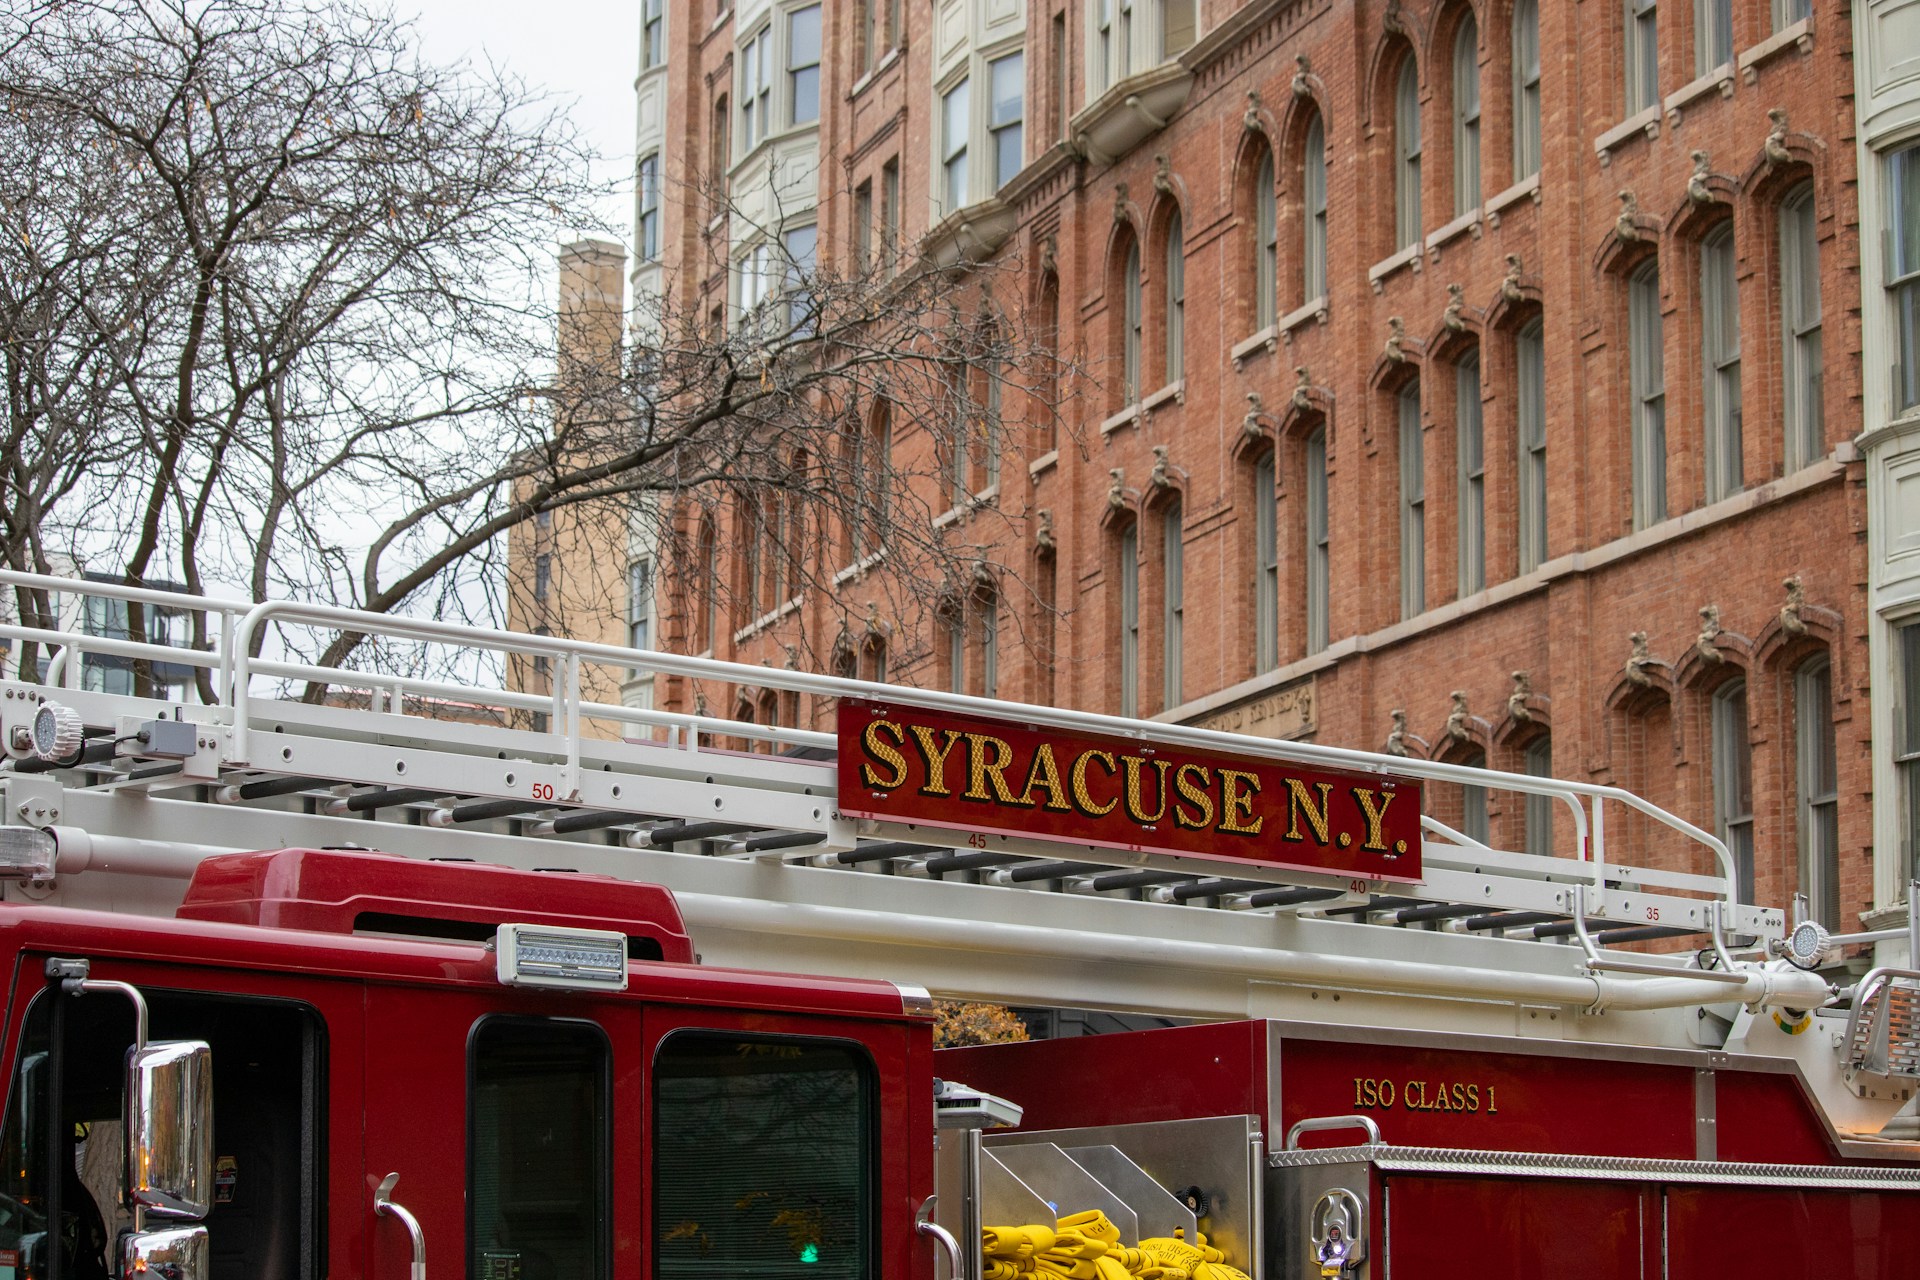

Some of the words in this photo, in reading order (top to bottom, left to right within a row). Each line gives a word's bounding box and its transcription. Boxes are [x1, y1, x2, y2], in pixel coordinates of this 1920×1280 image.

[532, 783, 553, 800] 50
[860, 719, 1264, 837] SYRACUSE
[1282, 777, 1408, 854] N.Y.
[968, 833, 986, 849] 45
[1350, 879, 1366, 894] 40
[1646, 906, 1660, 921] 35
[1354, 1078, 1396, 1108] ISO
[1404, 1080, 1480, 1112] CLASS
[1487, 1086, 1498, 1113] 1
[1180, 1258, 1198, 1272] PS
